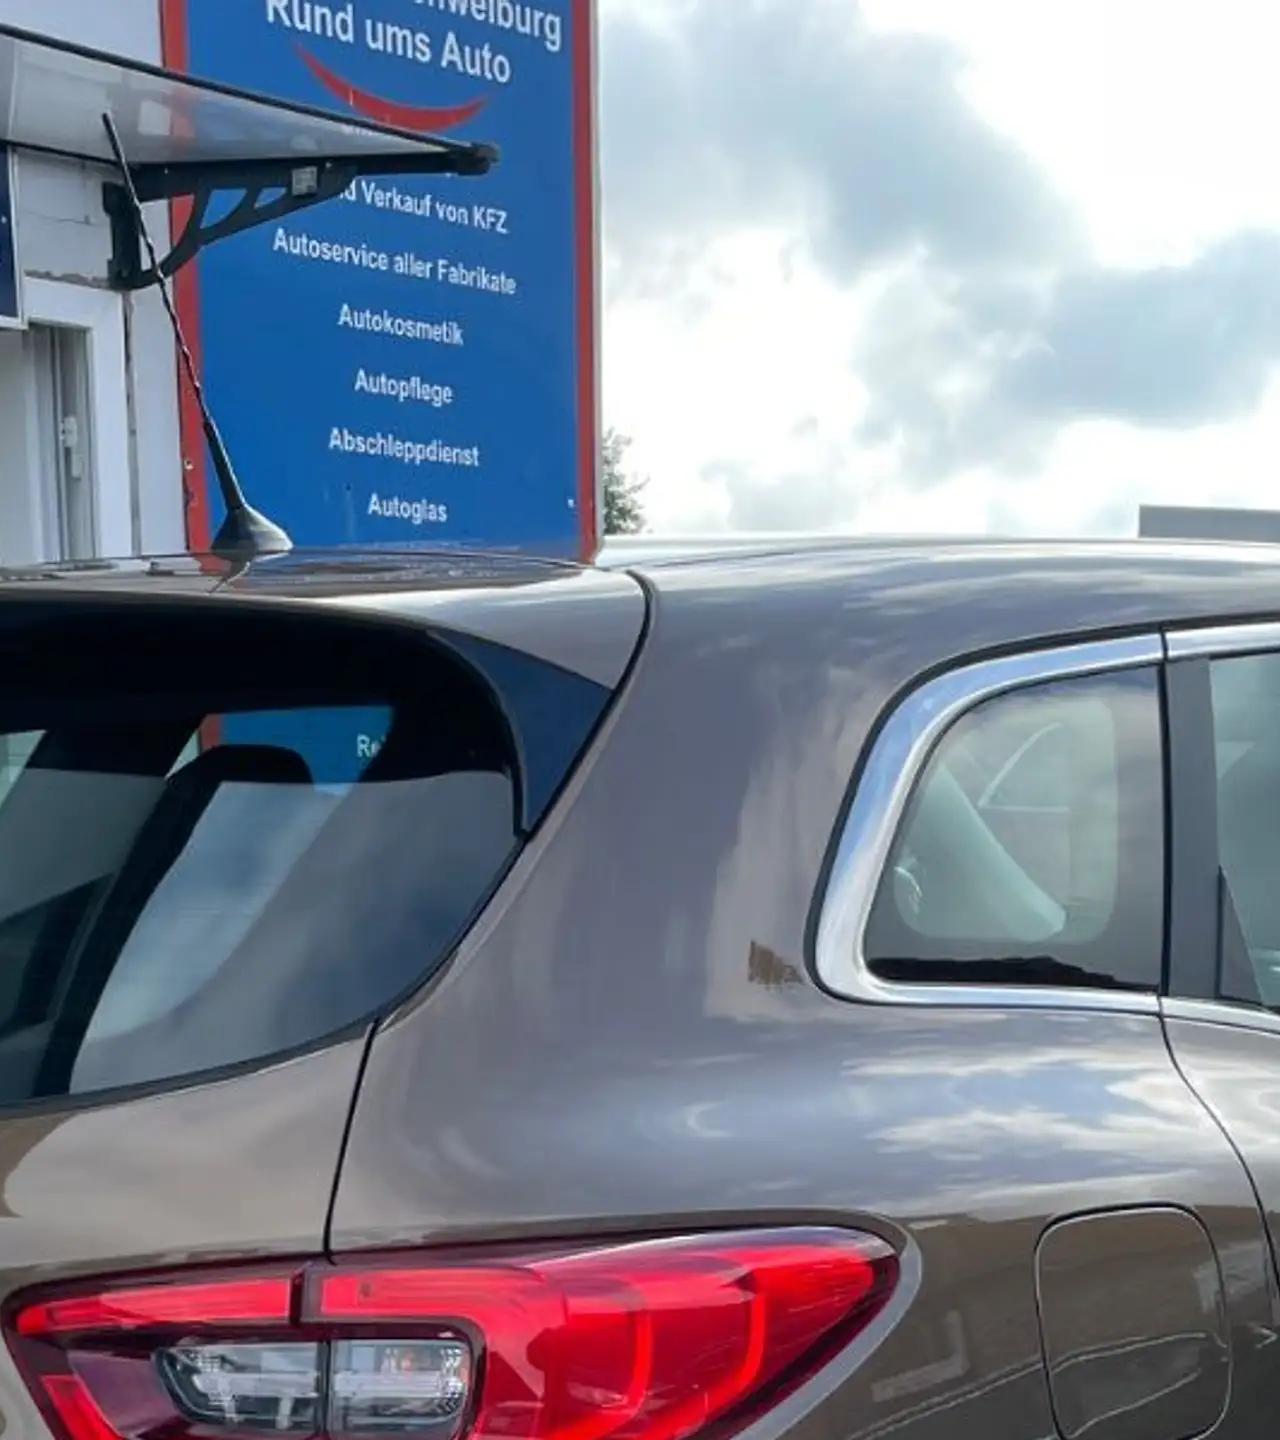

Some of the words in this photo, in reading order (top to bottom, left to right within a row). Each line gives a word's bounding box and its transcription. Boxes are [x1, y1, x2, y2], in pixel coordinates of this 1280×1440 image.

[265, 0, 354, 43] Rund
[366, 18, 431, 62] ums
[441, 32, 510, 83] Auto
[362, 180, 431, 217] Verkauf
[436, 201, 468, 225] von
[473, 206, 509, 234] KFZ
[273, 228, 388, 270] Autoservice
[393, 253, 433, 279] aller
[438, 260, 517, 295] Fabrikate
[338, 303, 464, 346] Autokosmetik
[354, 368, 454, 408] Autopflege
[328, 428, 480, 467] Abschleppdienst
[367, 492, 447, 524] Autoglas
